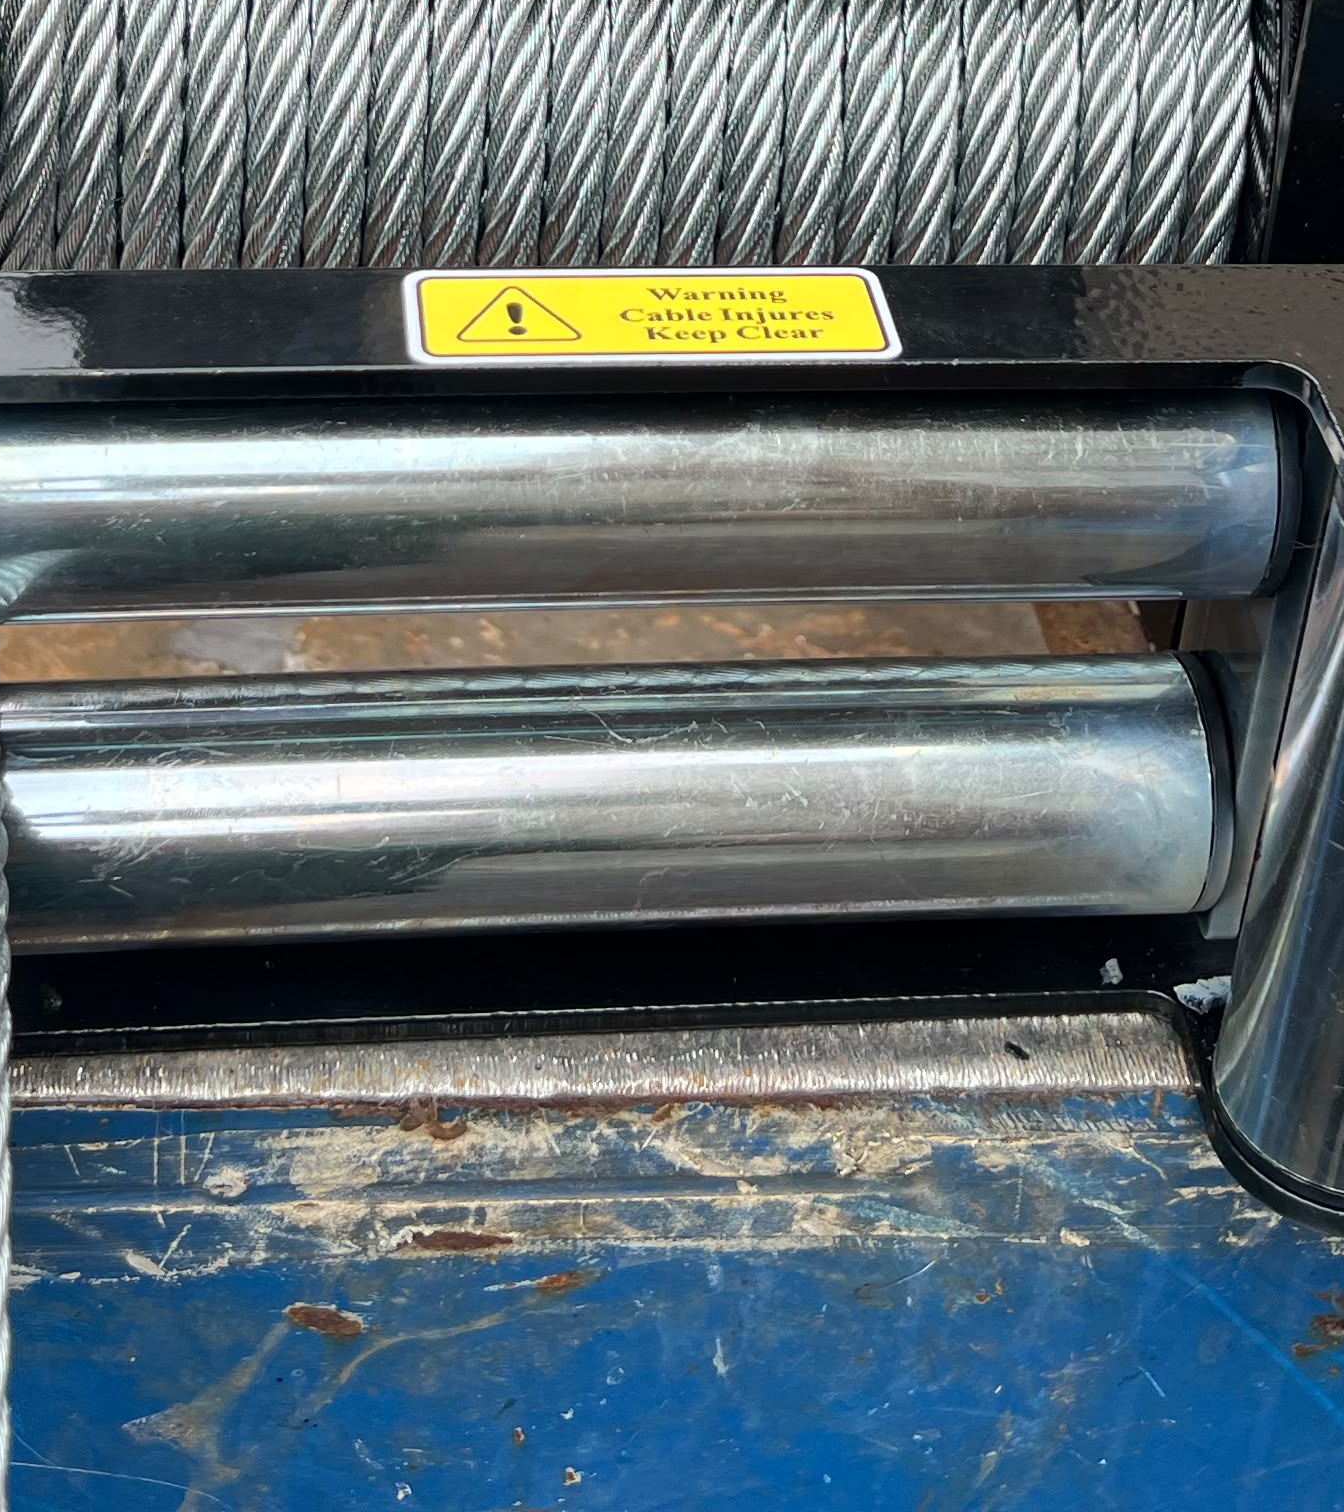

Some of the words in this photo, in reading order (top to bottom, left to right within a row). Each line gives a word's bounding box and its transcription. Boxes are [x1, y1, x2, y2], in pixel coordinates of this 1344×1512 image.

[646, 287, 787, 305] Warning
[619, 307, 714, 324] Cable
[718, 307, 835, 326] Injures
[646, 325, 728, 344] Keep
[736, 324, 826, 341] Clear
